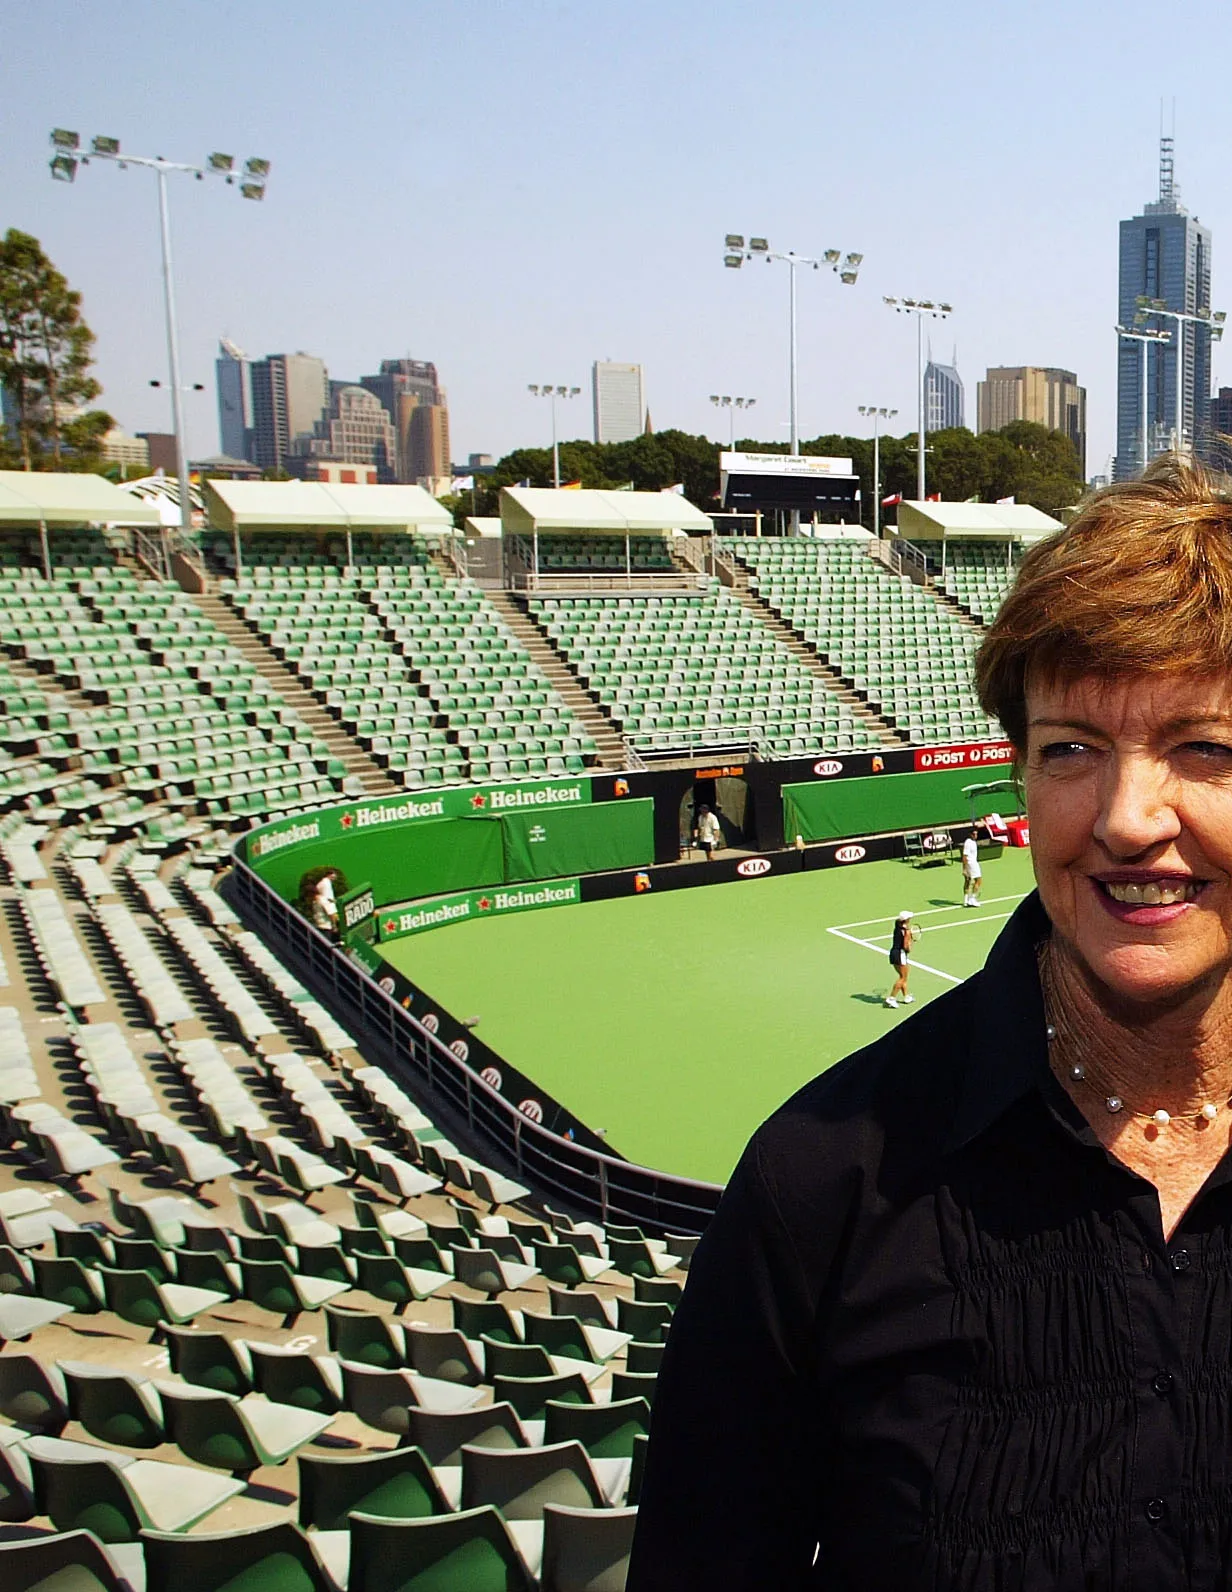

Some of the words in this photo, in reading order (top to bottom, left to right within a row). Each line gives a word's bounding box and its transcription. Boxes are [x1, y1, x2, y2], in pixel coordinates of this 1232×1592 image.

[934, 752, 965, 765] POST
[982, 748, 1012, 761] POST
[817, 763, 840, 774] KIA
[490, 786, 582, 809] Heineken
[357, 801, 444, 827] Heineken
[260, 822, 320, 855] Heineken
[838, 847, 862, 860] KIA
[742, 860, 767, 873] KIA
[495, 887, 576, 909] Heineken
[345, 897, 375, 927] RADO
[399, 902, 470, 931] Heineken
